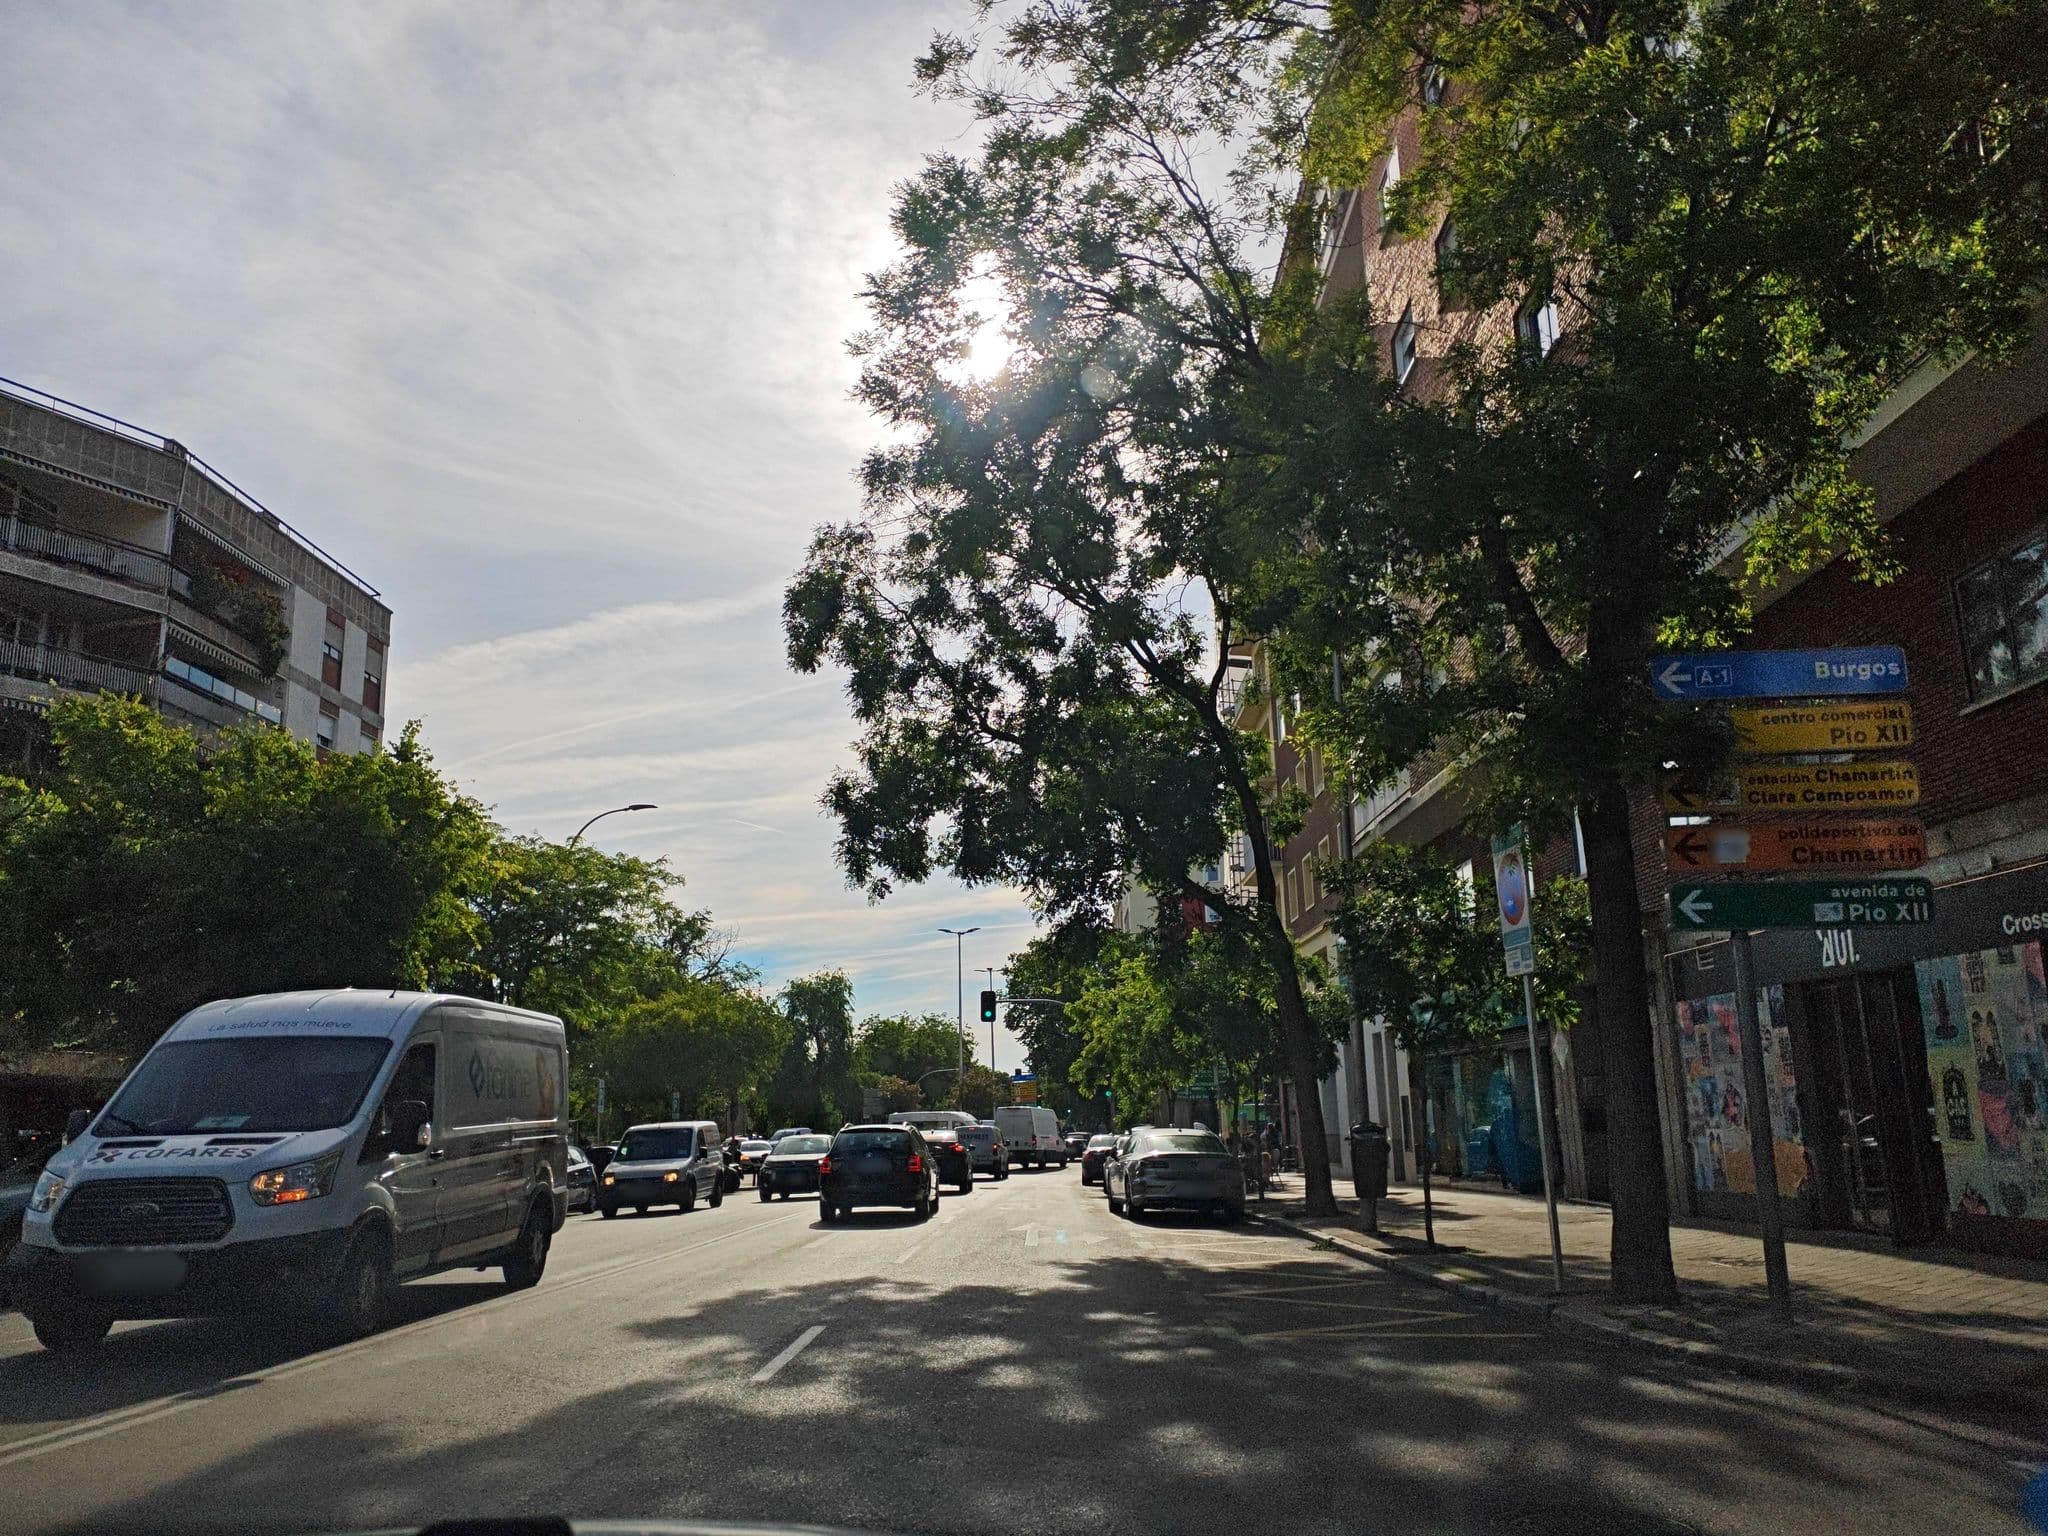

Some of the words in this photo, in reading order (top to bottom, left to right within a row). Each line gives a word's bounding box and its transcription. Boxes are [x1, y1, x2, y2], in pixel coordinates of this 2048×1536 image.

[1700, 668, 1729, 685] A-1
[1815, 661, 1901, 680] Burgos
[1762, 710, 1816, 725] centro
[1820, 706, 1905, 722] comercial
[1876, 724, 1908, 742] XII
[1748, 790, 1796, 804] Clara
[1802, 788, 1914, 806] Campoamor
[1778, 825, 1891, 842] polideportivo
[1897, 824, 1918, 836] de
[1831, 884, 1899, 898] avenida
[1904, 884, 1926, 897] de
[1895, 902, 1929, 922] XII
[230, 1020, 269, 1031] salud
[273, 1020, 301, 1029] nos
[304, 1020, 353, 1030] mueve
[128, 1146, 257, 1161] COFARES
